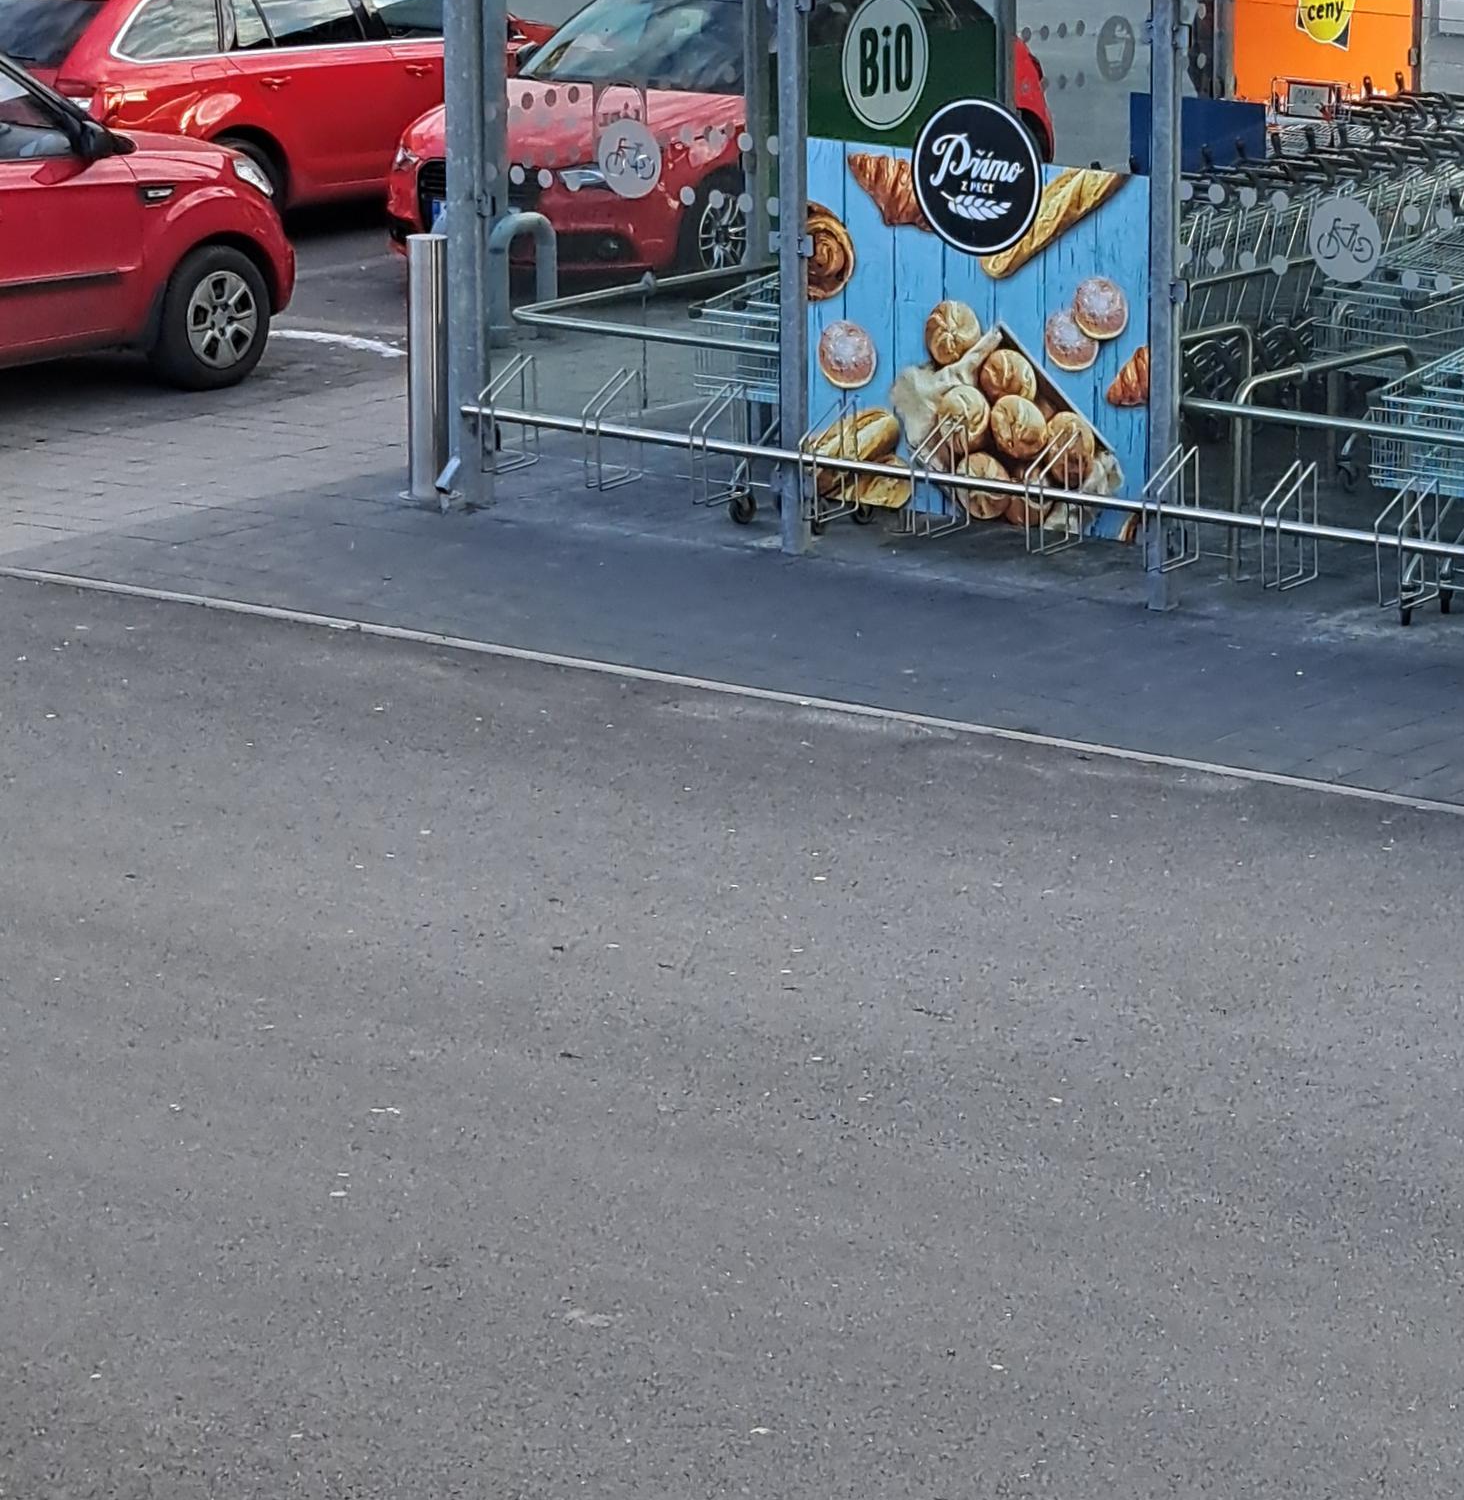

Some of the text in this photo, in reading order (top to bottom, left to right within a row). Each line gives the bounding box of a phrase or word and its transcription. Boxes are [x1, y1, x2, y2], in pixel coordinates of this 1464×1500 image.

[1307, 0, 1345, 22] ceny
[929, 133, 1025, 187] Přímo
[960, 180, 995, 195] Z PECE
